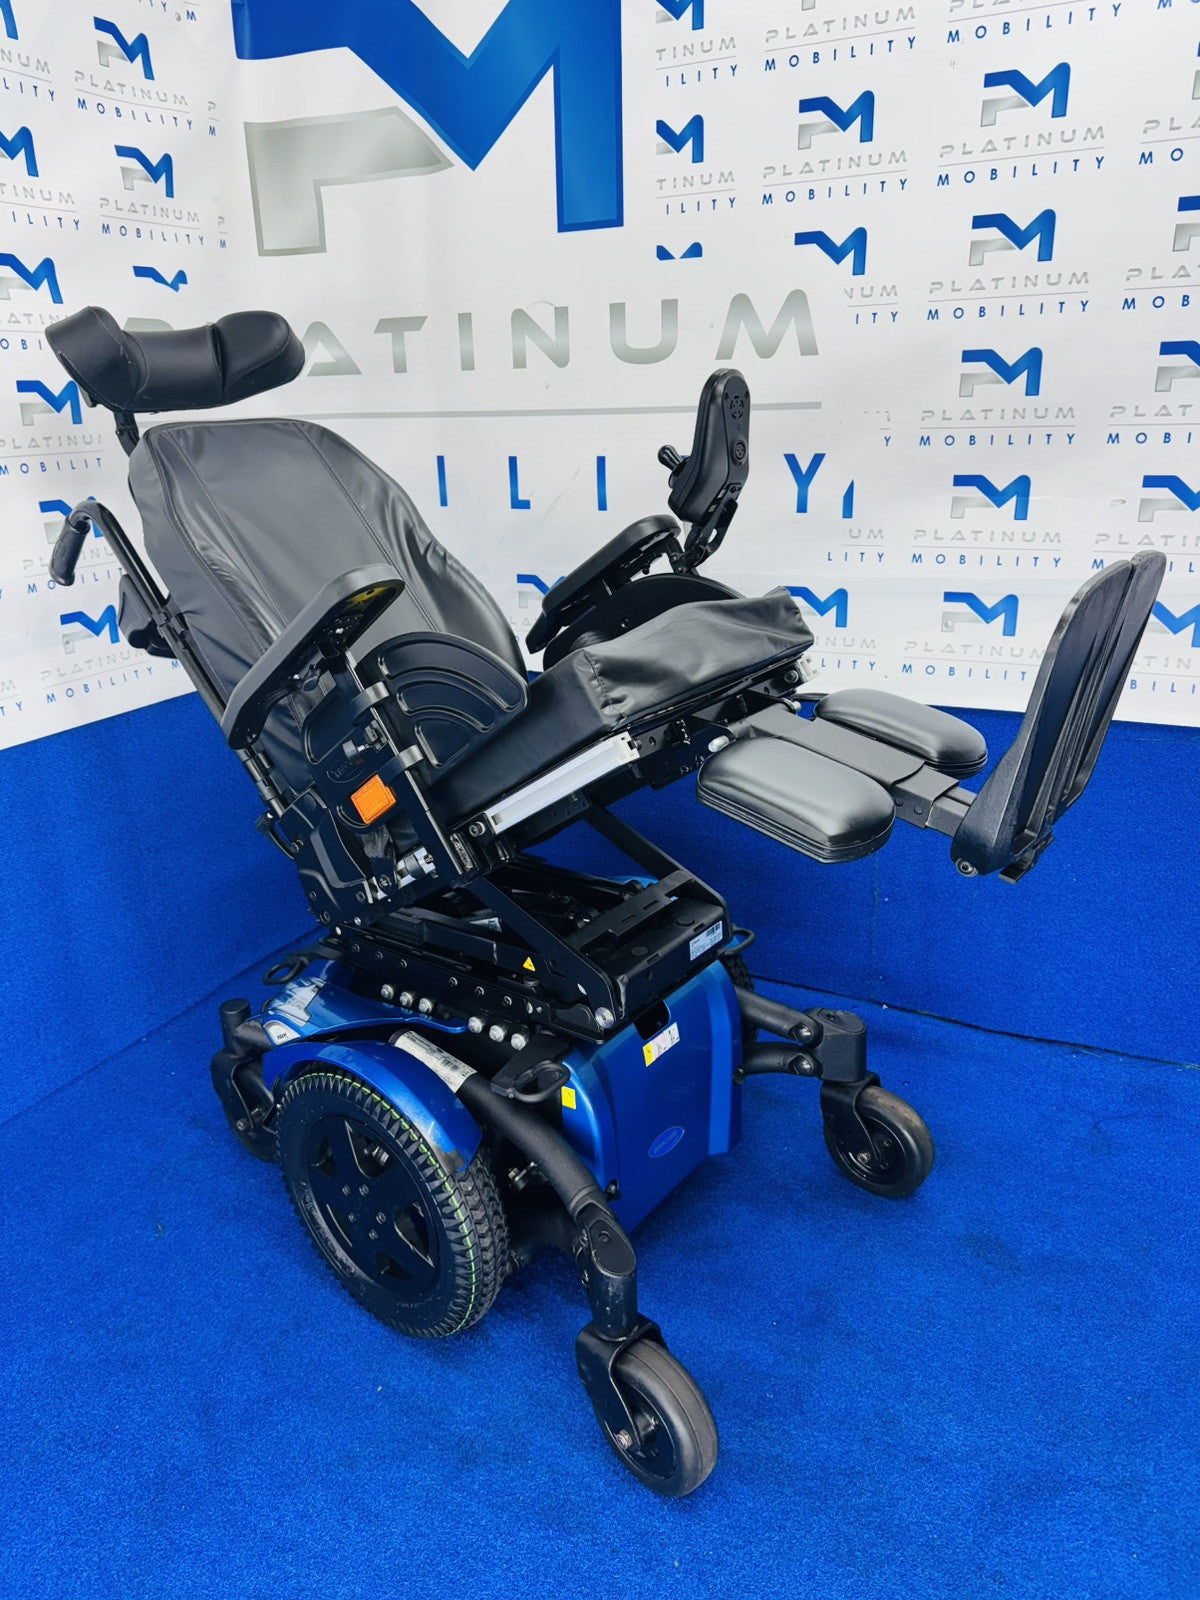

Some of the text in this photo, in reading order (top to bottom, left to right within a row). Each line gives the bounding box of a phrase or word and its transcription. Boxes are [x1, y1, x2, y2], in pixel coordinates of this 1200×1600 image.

[765, 6, 915, 43] PLATINUM
[946, 3, 1122, 44] MOBILITY
[764, 36, 916, 72] MOBILITY
[75, 70, 188, 106] PLATINUM
[77, 97, 193, 130] MOBILITY
[939, 125, 1105, 158] PLATINUM
[762, 150, 908, 179] PLATINUM
[937, 156, 1105, 187] MOBILITY
[761, 178, 908, 205] MOBILITY
[98, 197, 201, 223] PLATINUM
[101, 222, 205, 246] MOBILITY
[929, 271, 1090, 294] PLATINUM
[927, 300, 1090, 321] MOBILITY
[920, 406, 1076, 421] PLATINUM
[919, 433, 1076, 446] MOBILITY
[913, 528, 1062, 545] PLATINUM
[911, 553, 1062, 567] MOBILITY
[47, 666, 152, 705] MOBILITY
